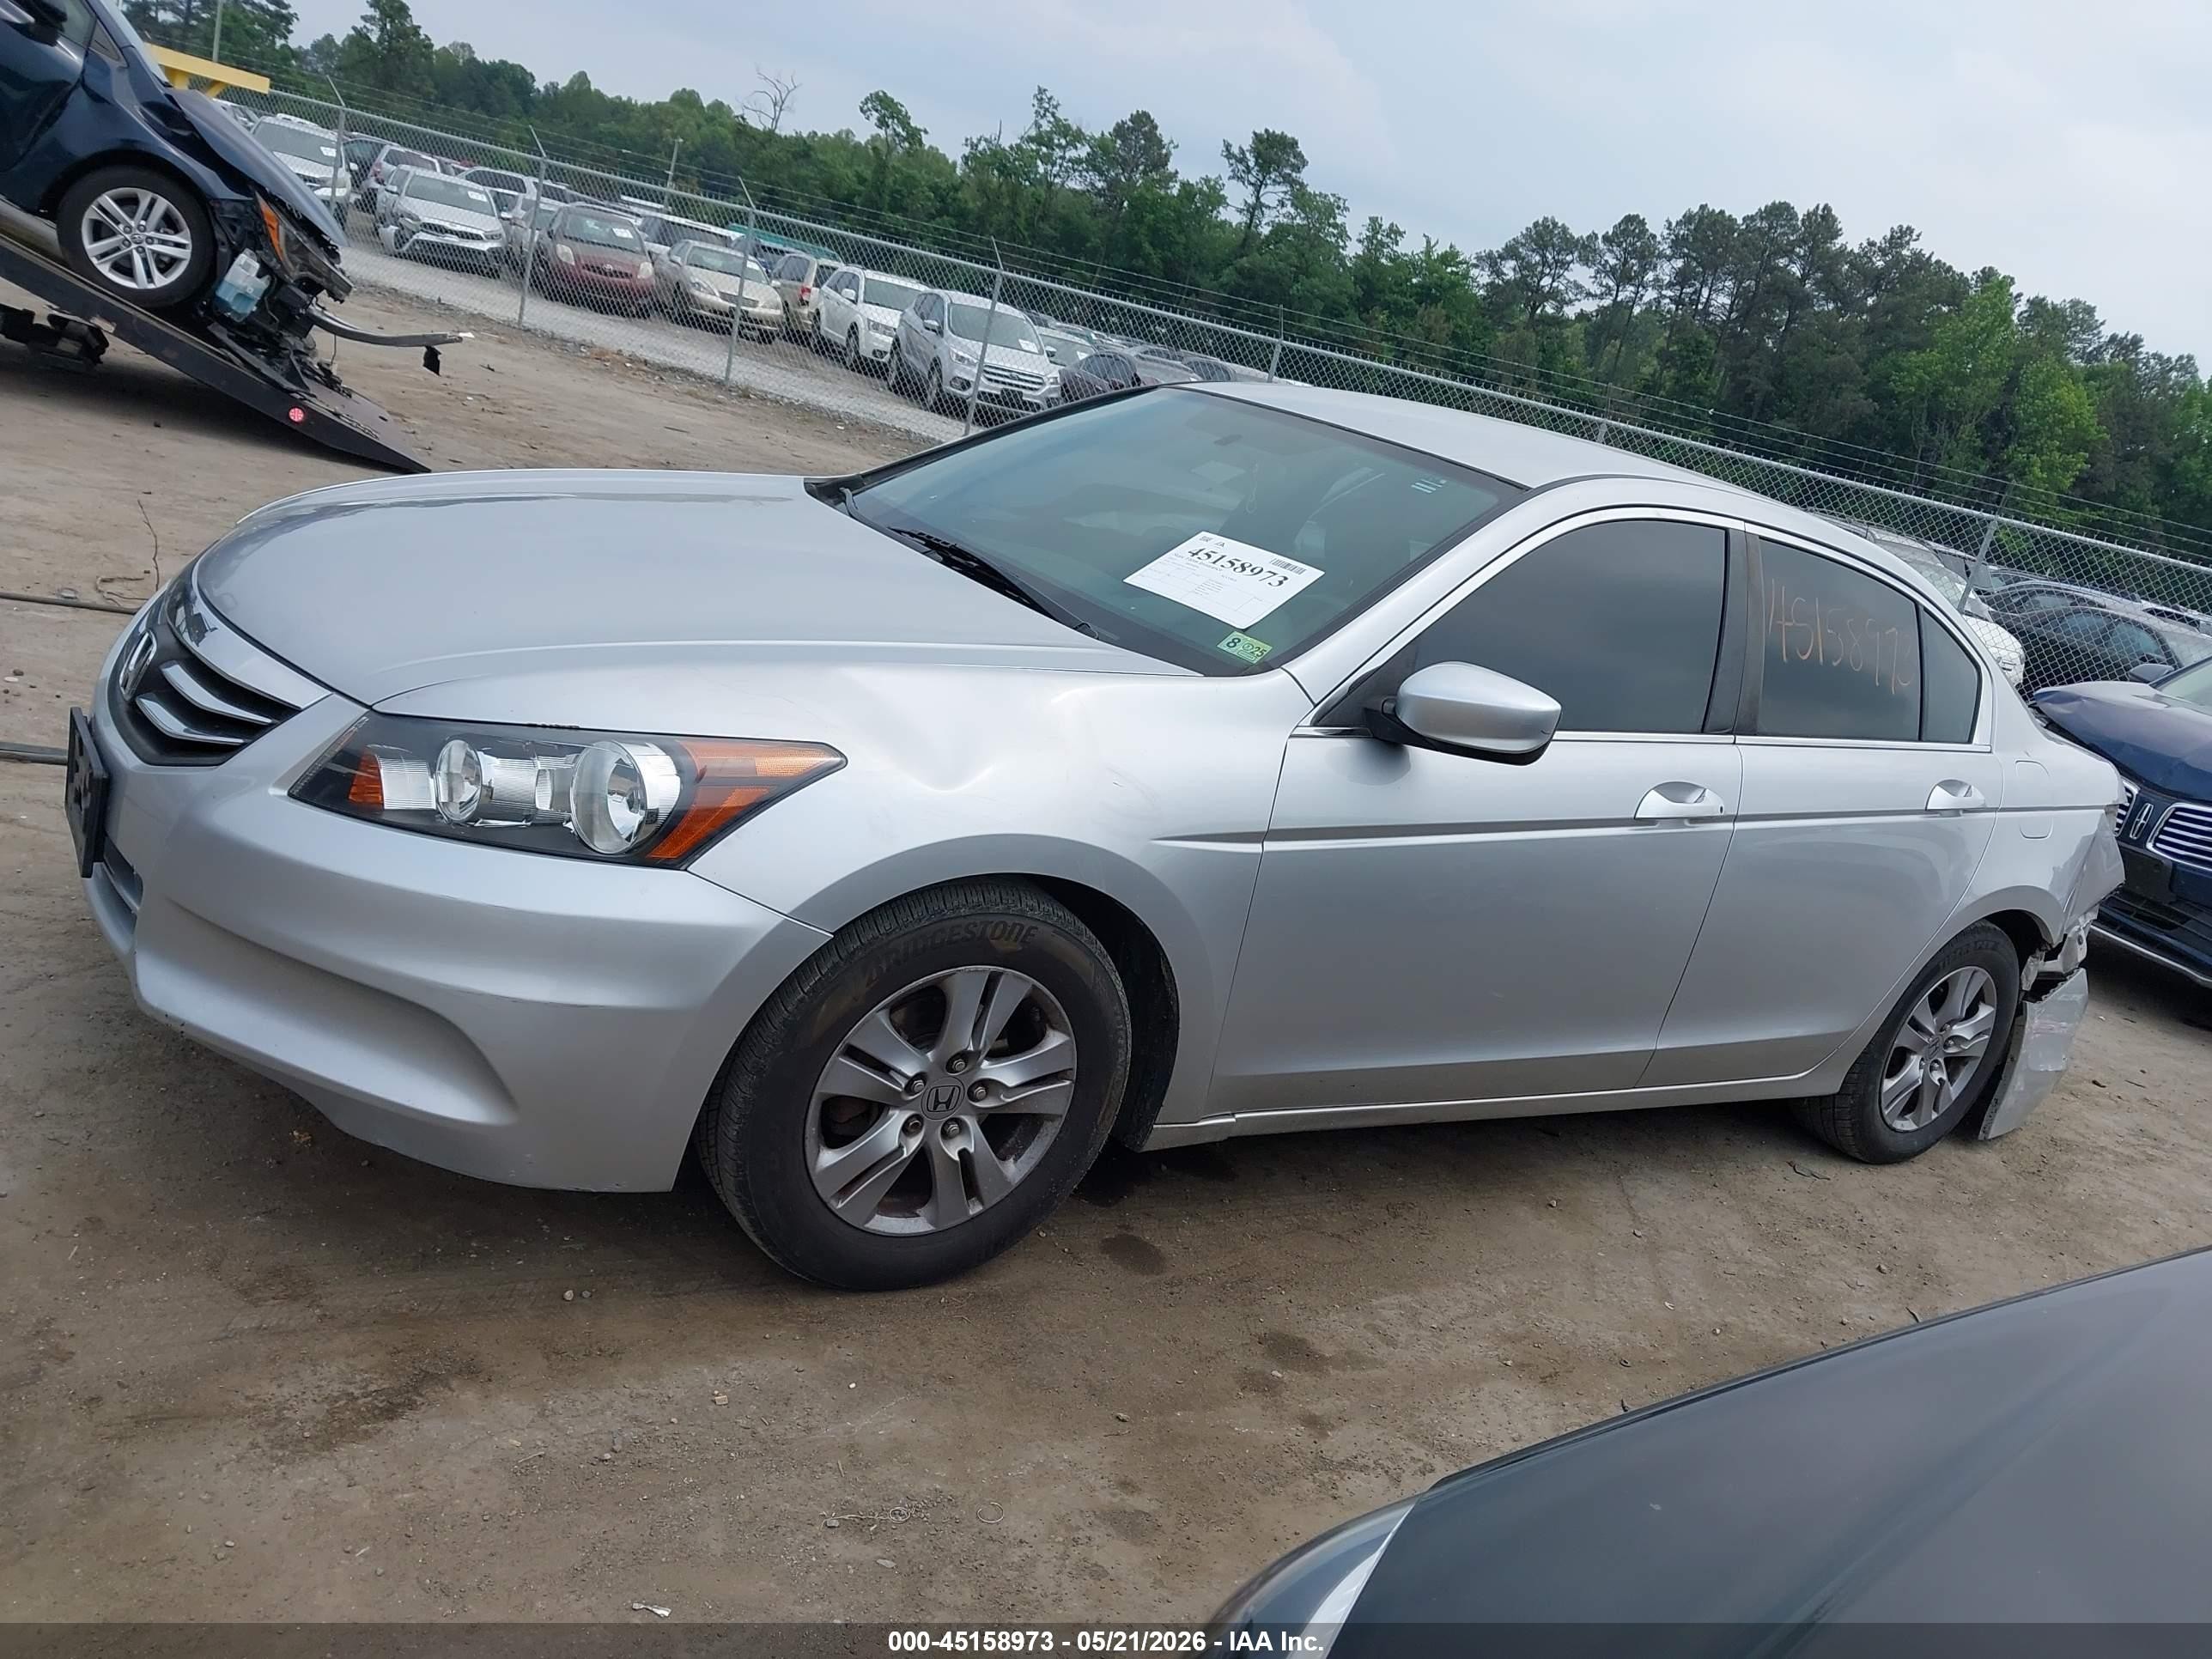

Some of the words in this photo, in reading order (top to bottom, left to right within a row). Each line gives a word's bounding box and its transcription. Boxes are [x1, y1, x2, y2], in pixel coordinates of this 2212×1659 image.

[1188, 548, 1289, 586] 45158973
[1226, 637, 1241, 648] 8
[1249, 646, 1267, 658] 25
